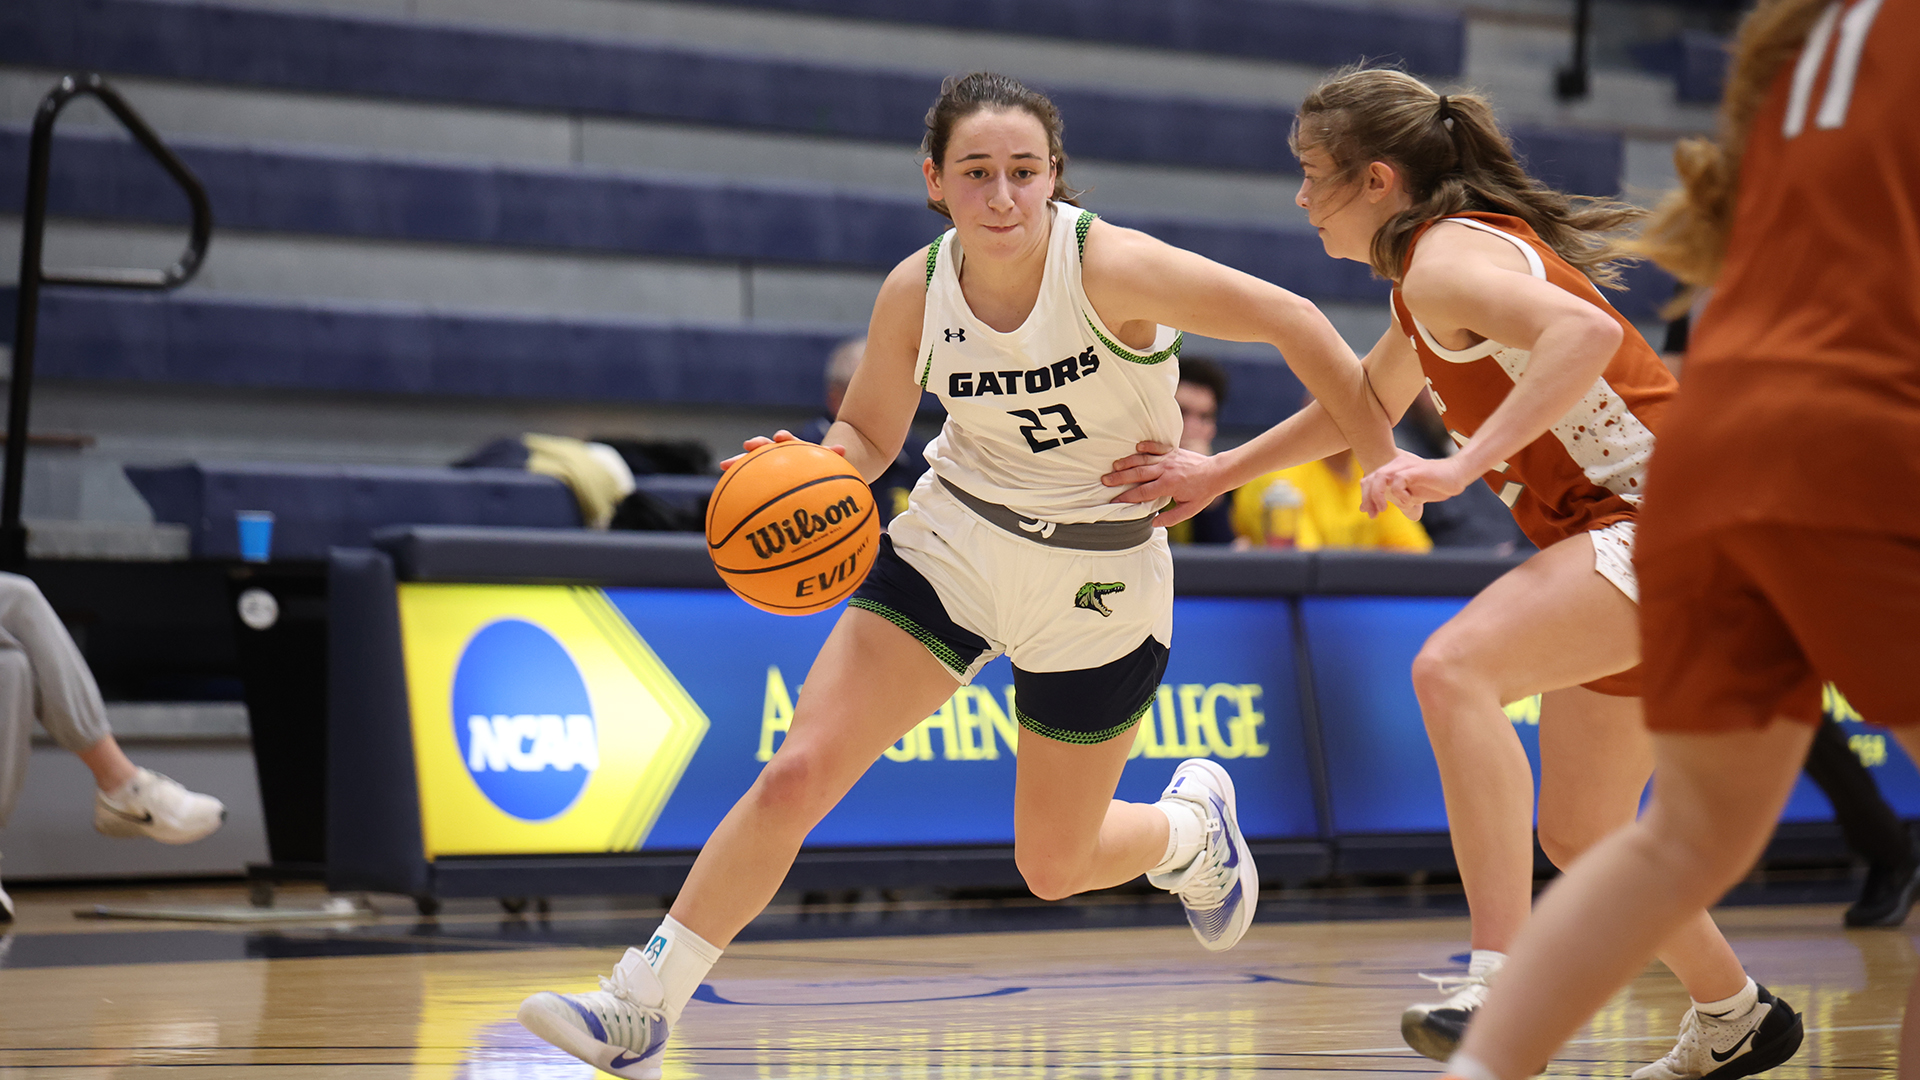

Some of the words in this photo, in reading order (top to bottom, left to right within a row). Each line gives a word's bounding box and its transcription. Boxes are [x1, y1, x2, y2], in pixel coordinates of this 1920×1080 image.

[1782, 0, 1884, 139] 11
[948, 345, 1100, 398] GATORS
[1006, 403, 1089, 454] 23
[745, 495, 860, 560] Wilson
[467, 714, 600, 773] NCAA
